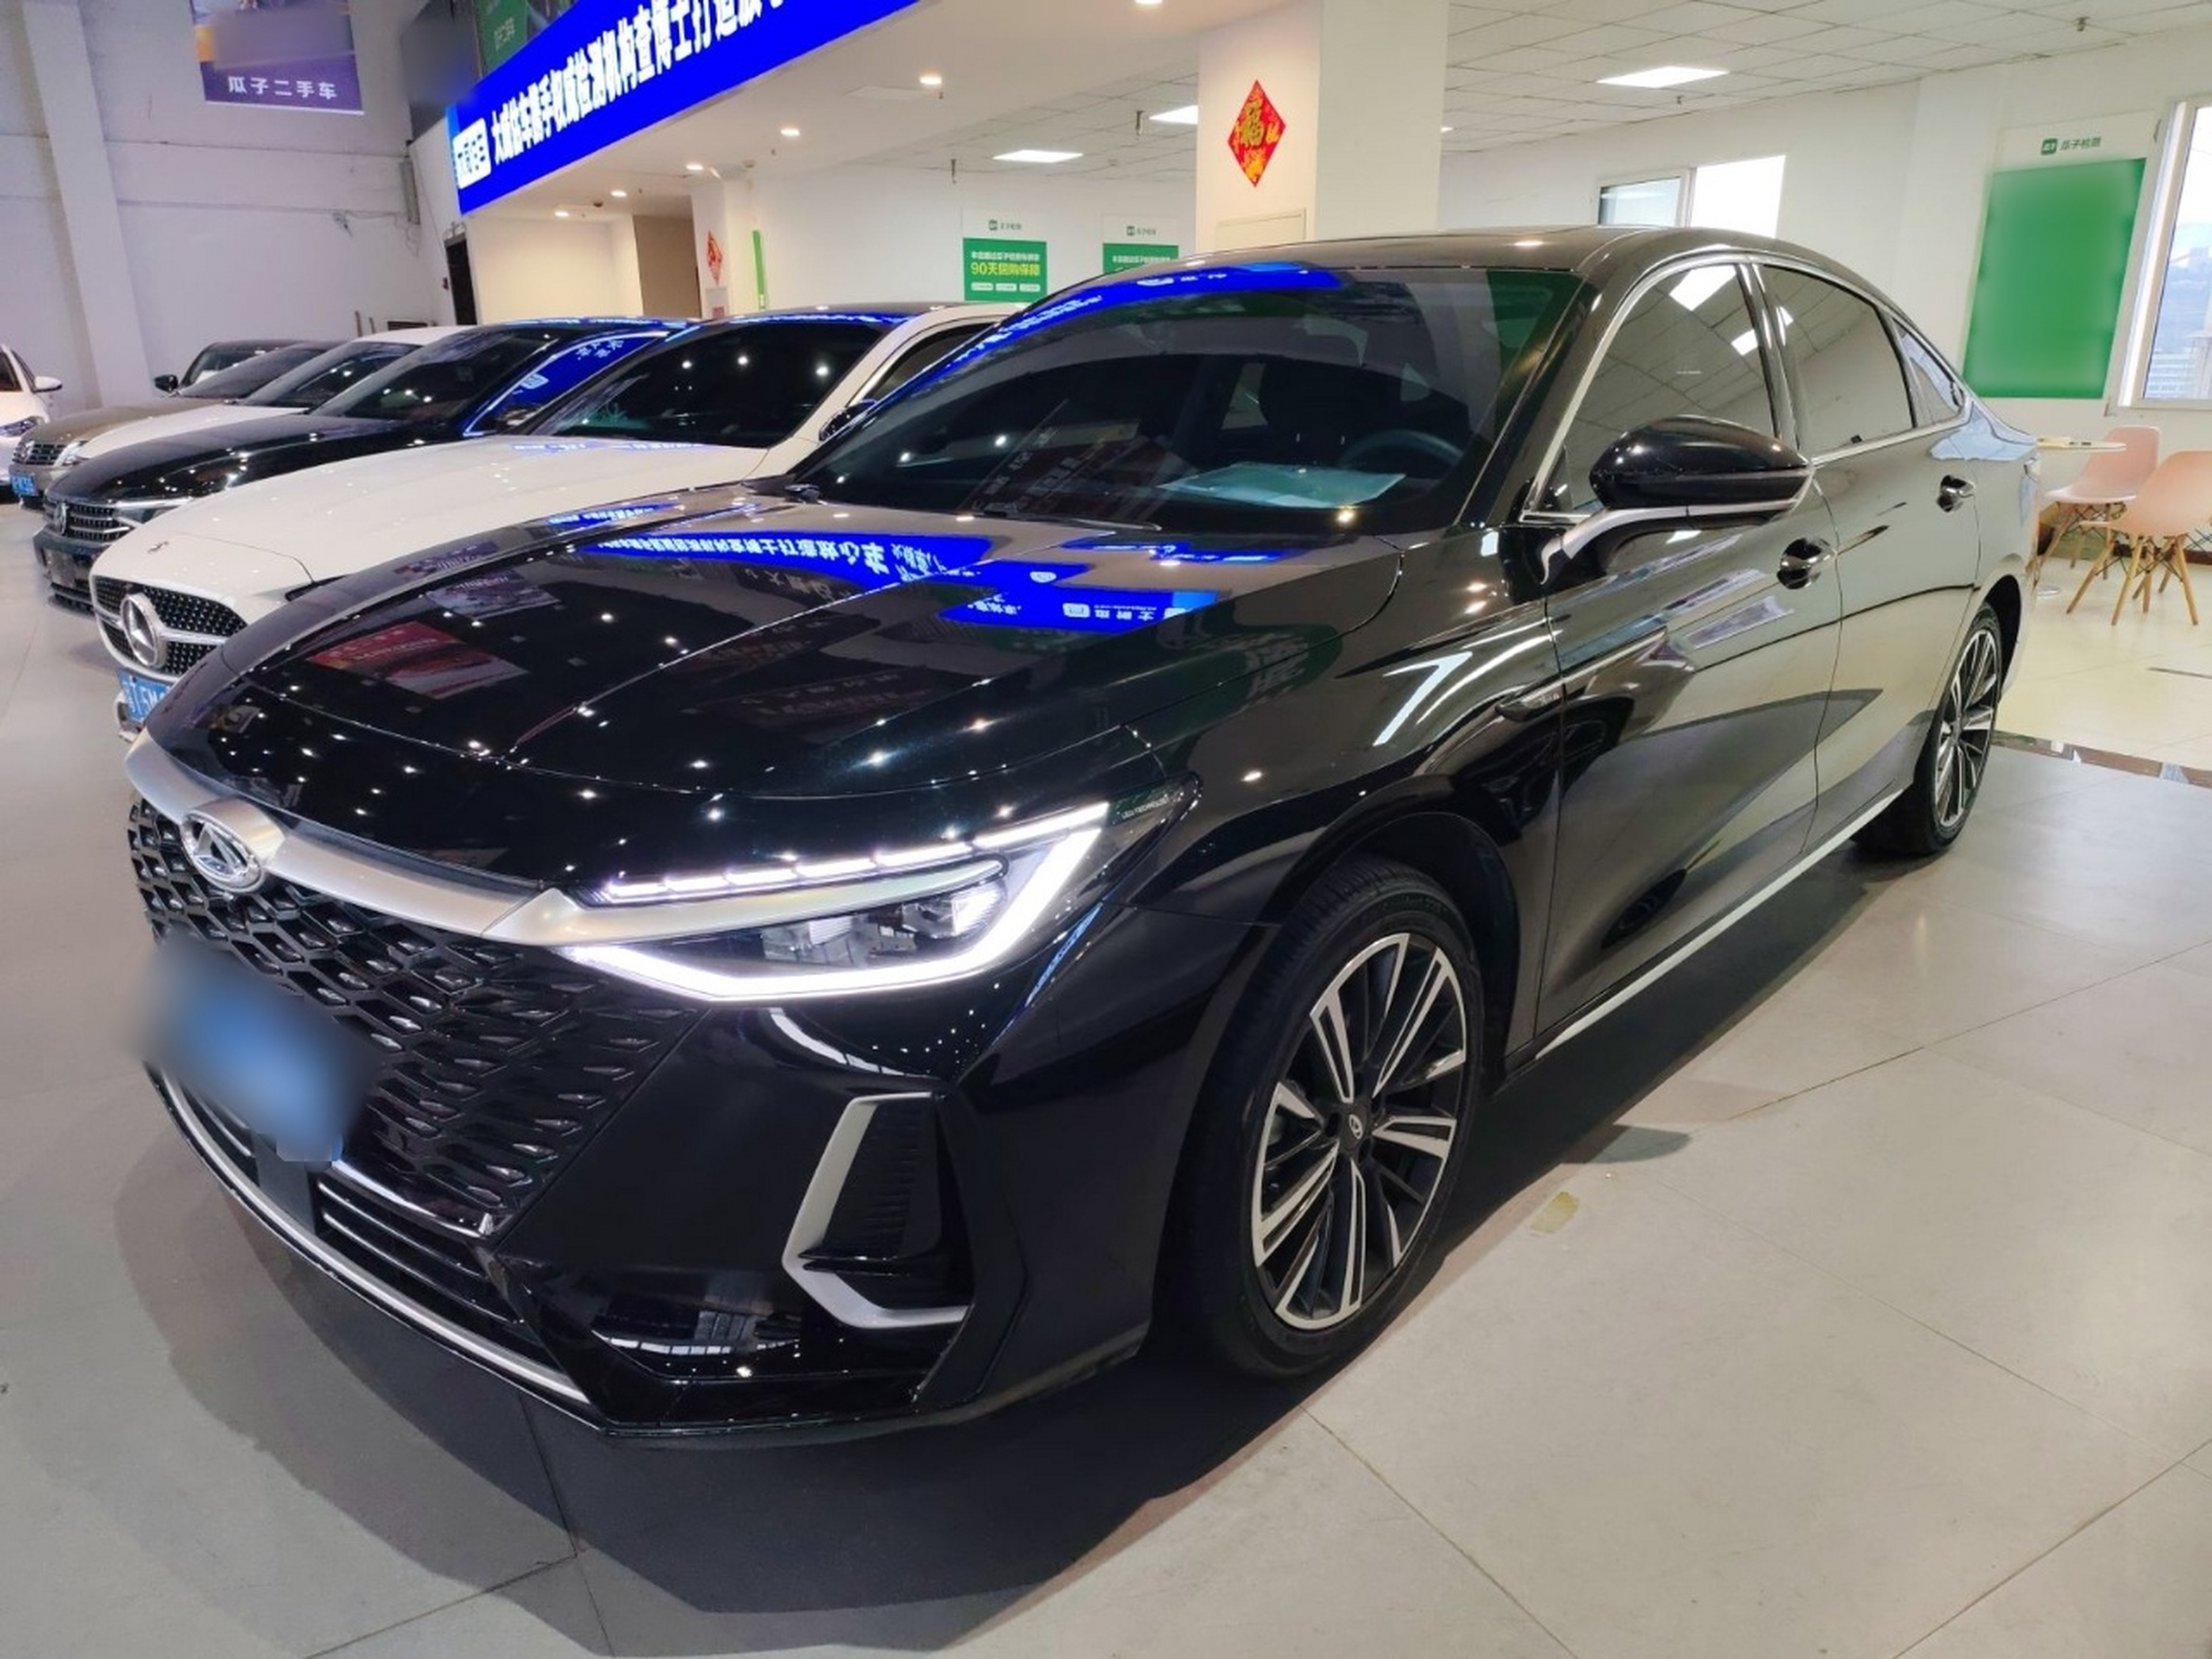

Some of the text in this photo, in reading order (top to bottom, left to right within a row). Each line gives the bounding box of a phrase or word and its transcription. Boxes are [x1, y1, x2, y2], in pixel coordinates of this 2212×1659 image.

[228, 76, 338, 100] 瓜子二手车
